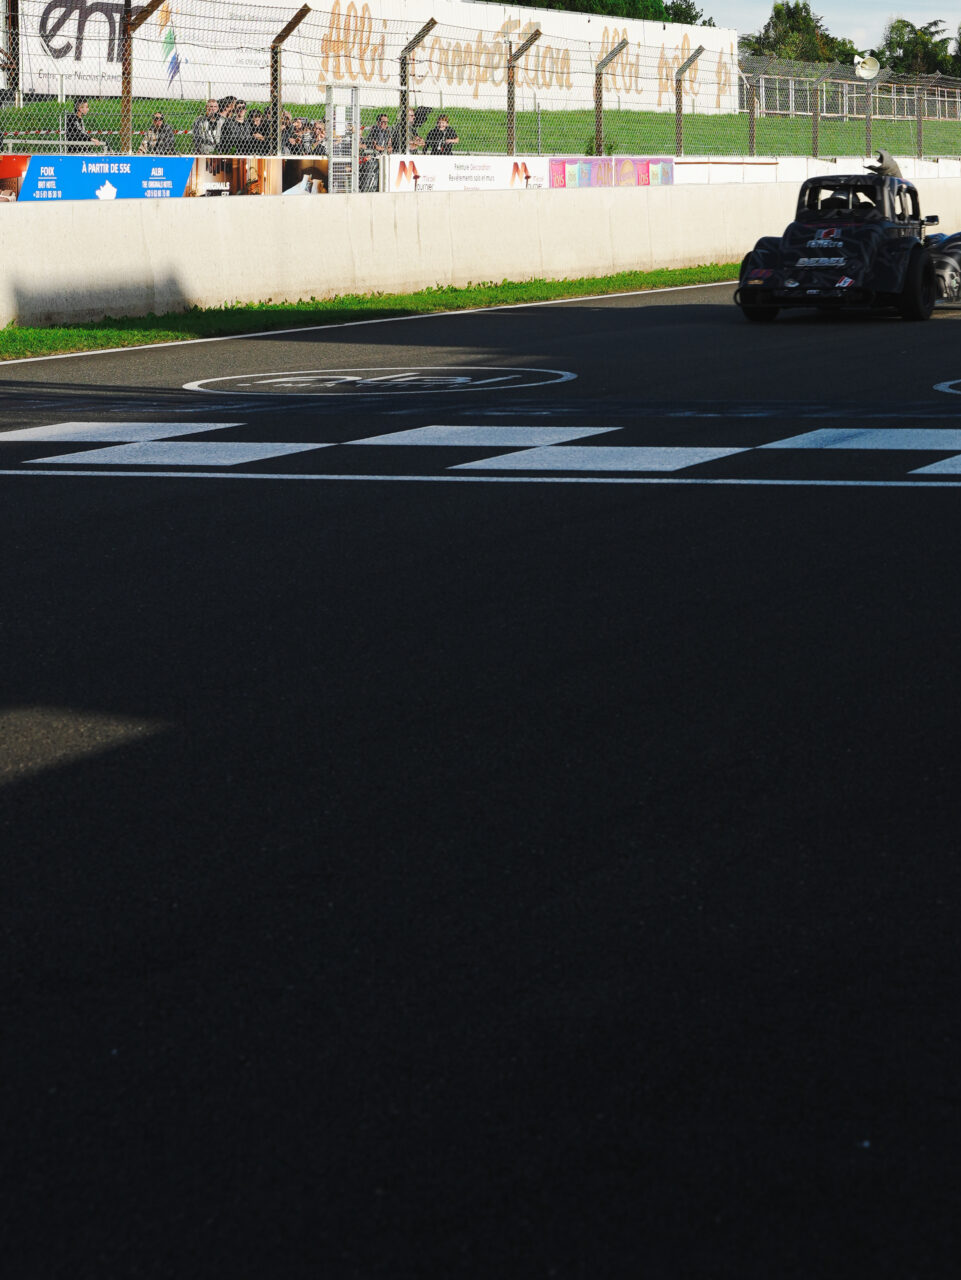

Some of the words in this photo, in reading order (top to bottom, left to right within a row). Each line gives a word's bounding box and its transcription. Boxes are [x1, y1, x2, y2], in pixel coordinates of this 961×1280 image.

[40, 166, 55, 176] FOIX
[88, 163, 109, 173] PARTIR
[110, 163, 119, 173] DE
[151, 167, 163, 176] ALBI
